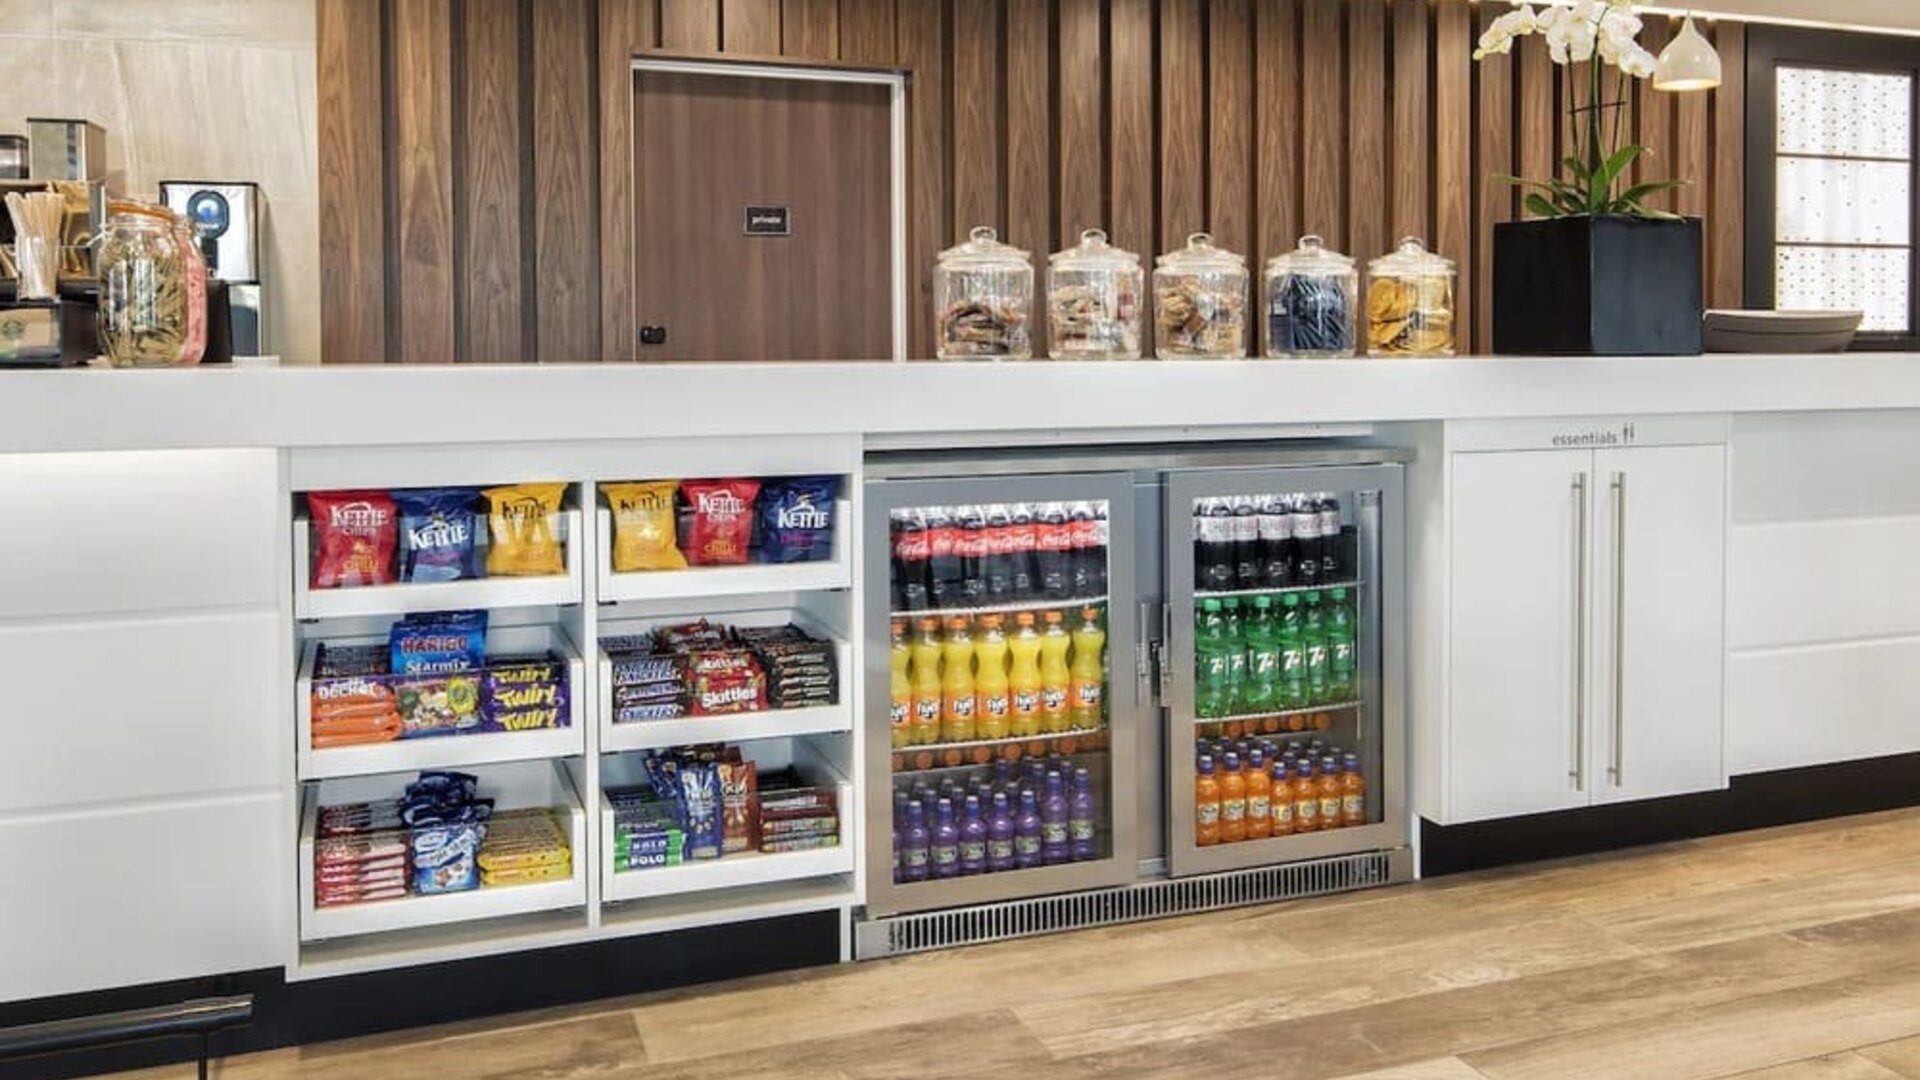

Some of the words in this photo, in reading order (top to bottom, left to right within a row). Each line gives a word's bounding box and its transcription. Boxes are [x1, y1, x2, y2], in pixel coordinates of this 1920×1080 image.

[752, 215, 781, 225] private
[1552, 430, 1618, 446] essentials
[330, 502, 389, 527] KETTLE
[777, 504, 829, 528] KETTLE
[408, 521, 469, 550] KETTLE
[403, 635, 468, 653] HARIBO
[406, 658, 471, 673] Starmix
[494, 684, 556, 708] Twirl
[702, 688, 757, 707] Skittles
[496, 707, 557, 731] Twirl
[630, 853, 666, 866] POLO
